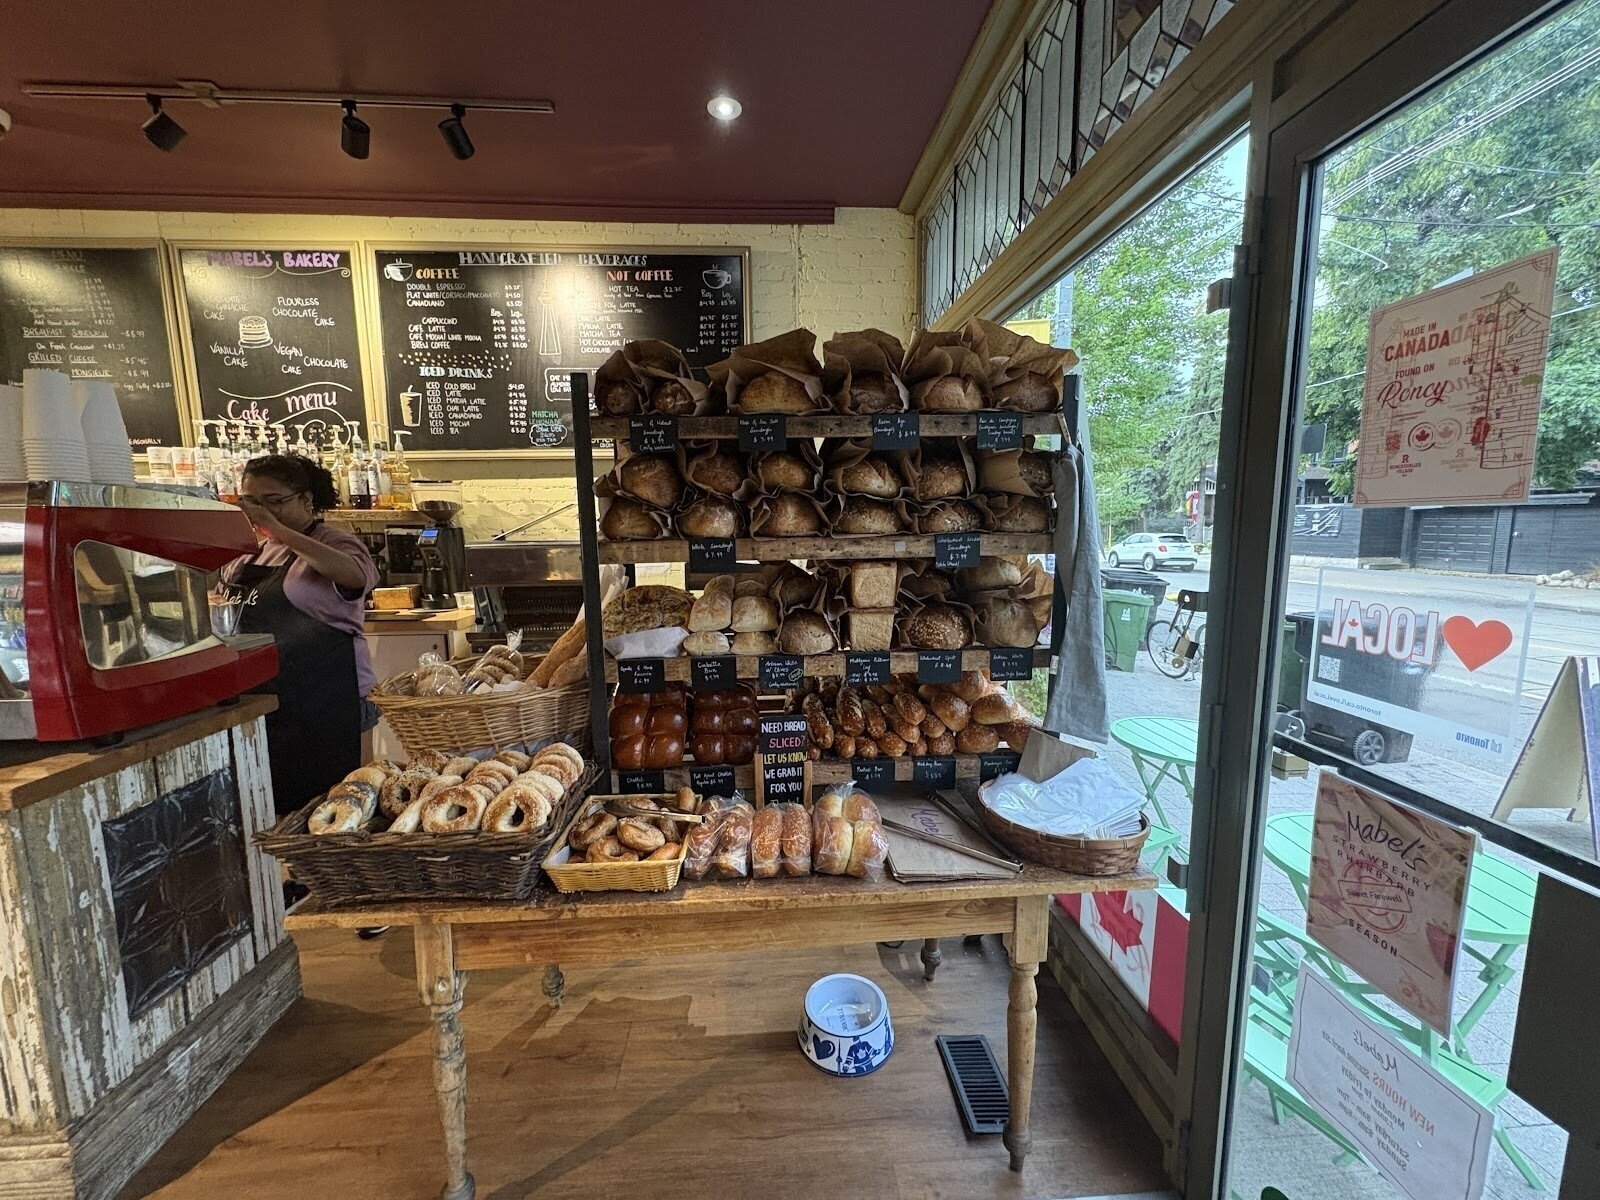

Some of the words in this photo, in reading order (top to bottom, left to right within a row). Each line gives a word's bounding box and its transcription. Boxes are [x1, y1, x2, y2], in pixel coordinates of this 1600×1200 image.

[283, 252, 341, 268] BAKERY
[459, 252, 562, 265] HANDCRAFTED
[578, 254, 648, 266] BEVERAGES
[416, 268, 459, 279] COFFEE
[607, 270, 631, 281] NOT
[635, 270, 673, 281] COFFEE
[277, 297, 319, 306] FLOURLESS
[203, 310, 225, 320] CAKE
[273, 306, 318, 318] CHOCOLATE
[314, 317, 335, 326] CAKE
[422, 317, 458, 325] CAPPUCCINO
[1403, 326, 1425, 339] MADE
[1428, 322, 1437, 334] IN
[210, 342, 245, 355] VANILLA
[431, 341, 451, 349] COFFEE
[1384, 330, 1450, 362] CANADA
[28, 352, 62, 361] GRILLED
[274, 343, 303, 360] VEGAN
[224, 356, 248, 368] CAKE
[304, 356, 349, 369] CHOCOLATE
[282, 364, 302, 375] CAKE
[419, 367, 445, 377] ICED
[448, 367, 493, 379] DRINKS
[1395, 365, 1421, 379] FOUND
[1424, 363, 1434, 374] ON
[1378, 379, 1450, 409] Roncy
[227, 399, 269, 422] Cake
[1402, 454, 1409, 463] R
[762, 722, 783, 733] NEED
[784, 721, 806, 731] BREAD
[769, 736, 805, 748] SLICED?
[764, 754, 776, 764] LET
[778, 753, 787, 763] US
[788, 752, 807, 762] KNOW
[765, 769, 775, 779] WE
[777, 767, 796, 777] GRAB
[797, 767, 802, 776] IT
[770, 784, 786, 793] FOR
[788, 782, 802, 791] YOU
[1347, 811, 1428, 871] Mabel's
[1332, 834, 1432, 892] STRAWBERRY
[1349, 918, 1398, 957] SEASON
